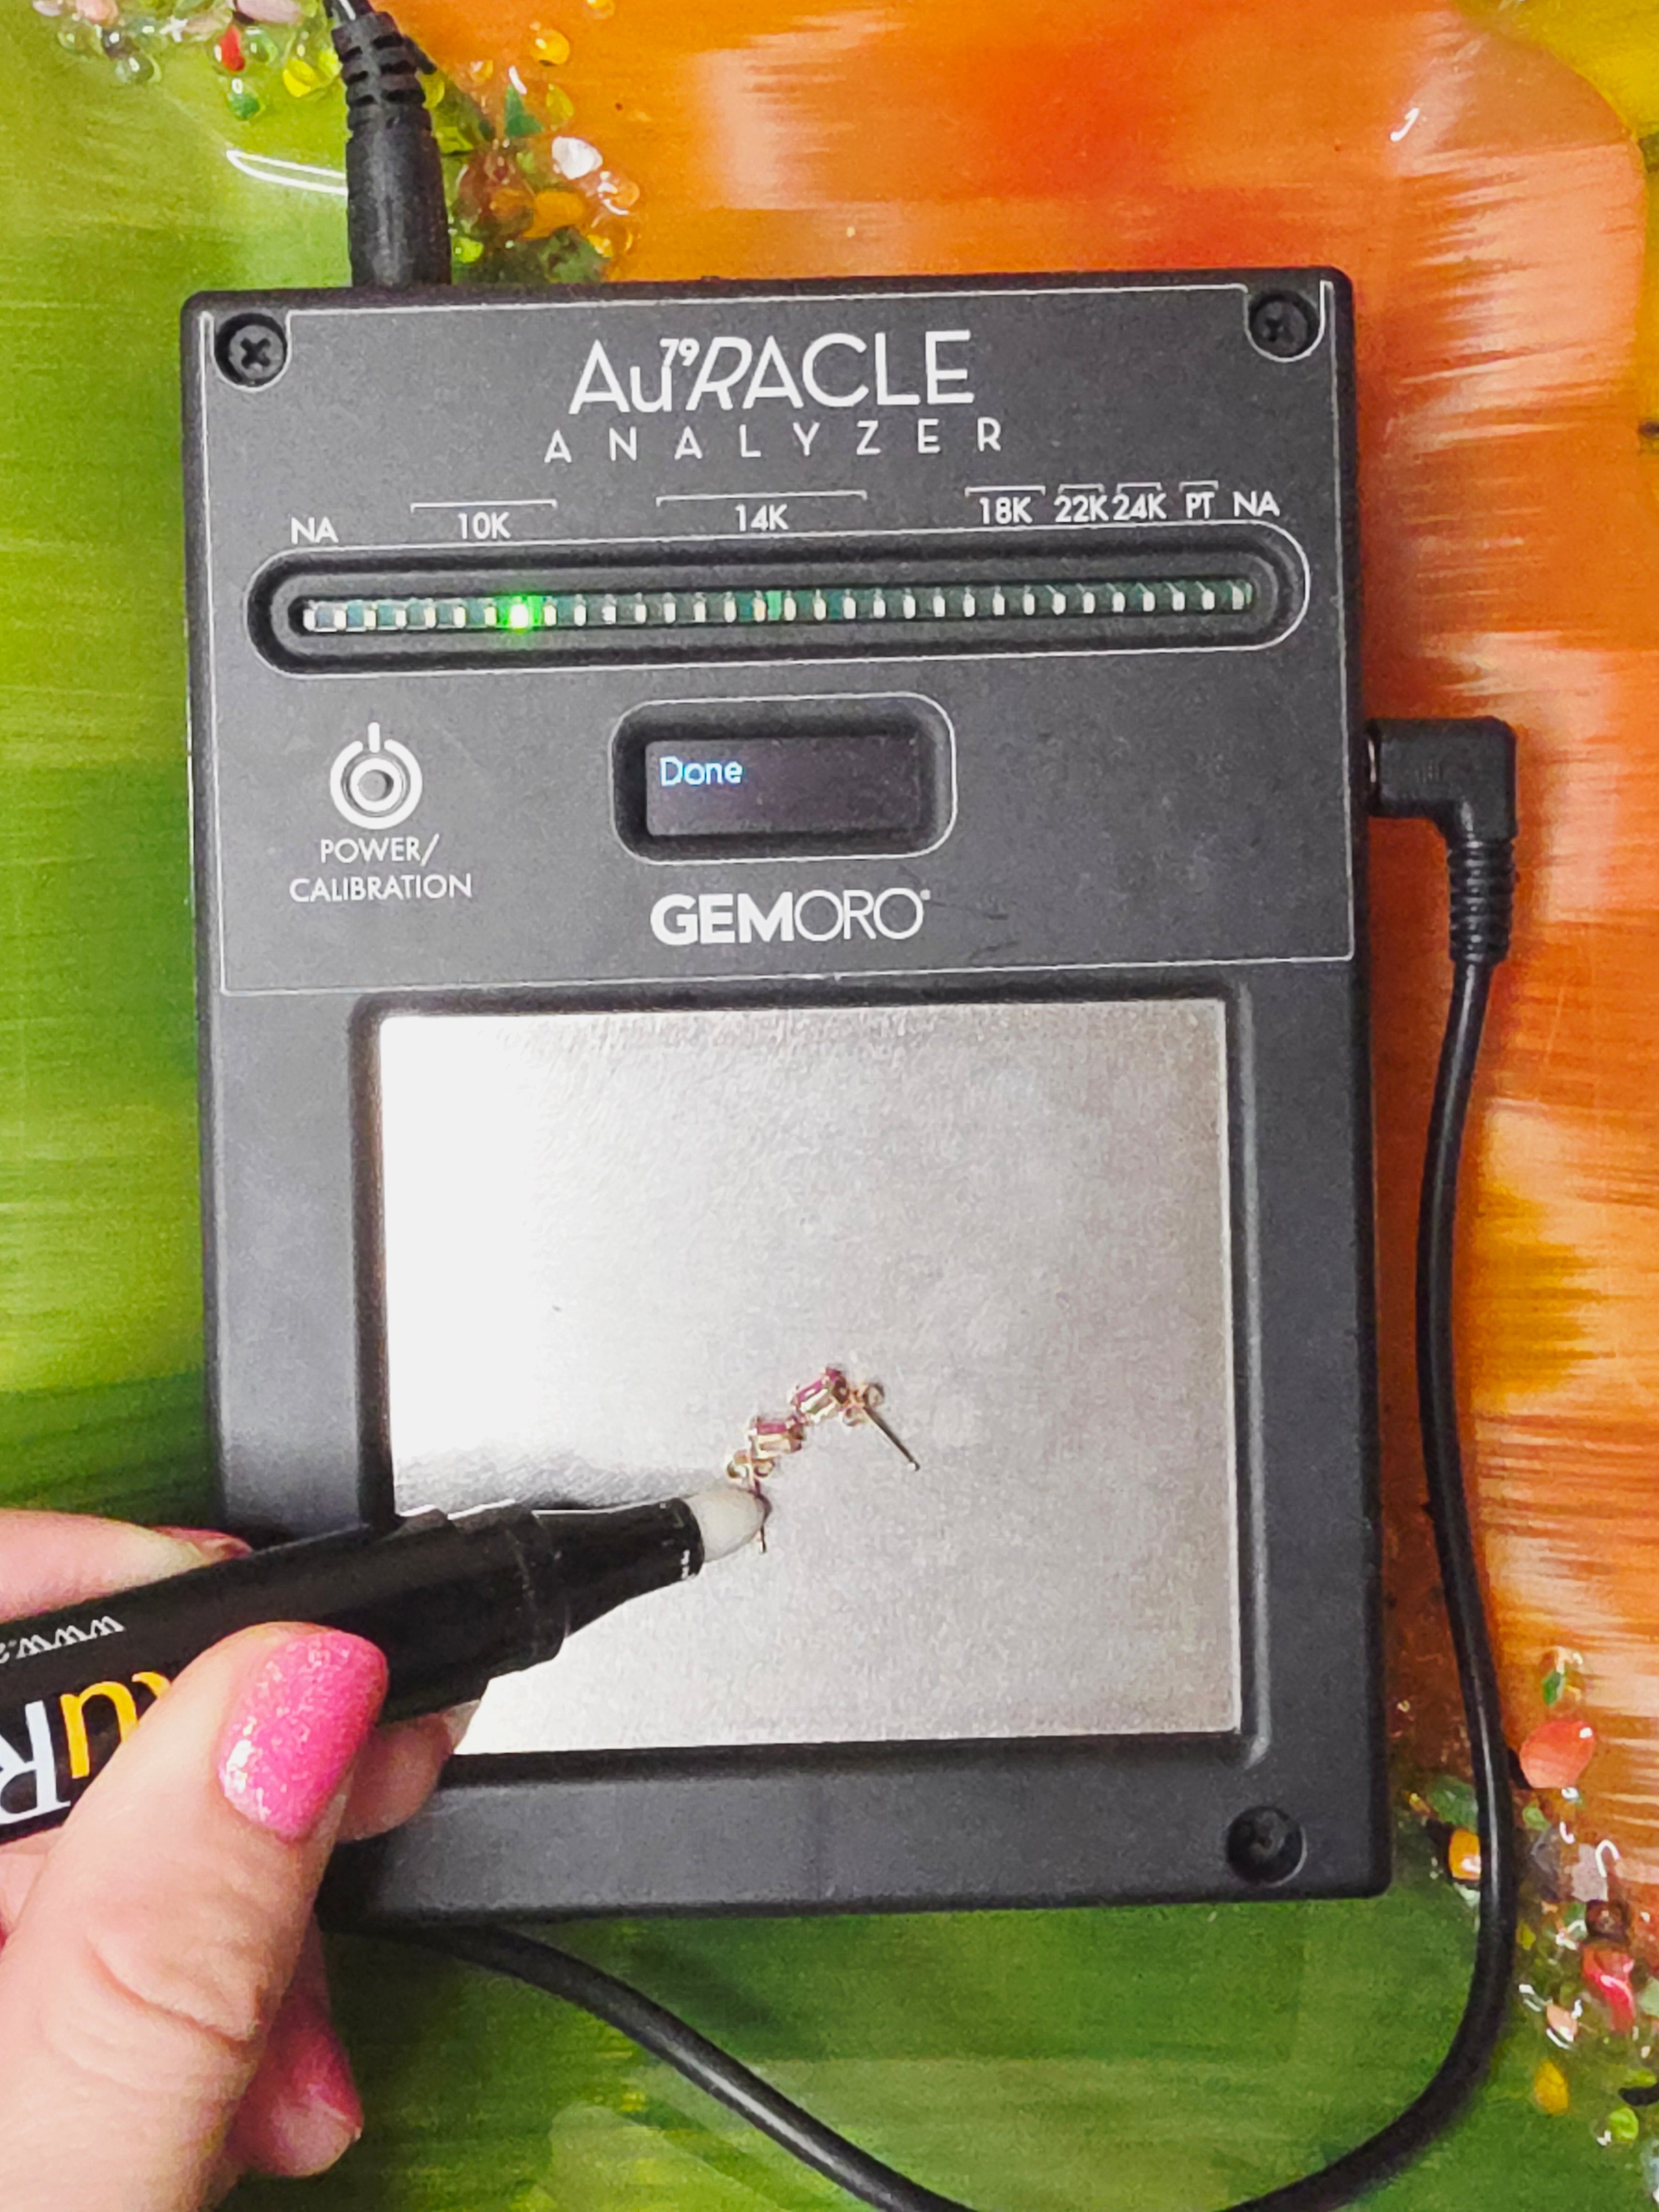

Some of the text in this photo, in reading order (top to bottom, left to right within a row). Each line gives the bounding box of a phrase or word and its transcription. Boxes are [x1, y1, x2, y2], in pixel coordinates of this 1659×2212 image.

[544, 418, 1001, 463] ANALYZER
[290, 490, 1280, 544] NA 10K 14K 18K 22K 24K PT NA
[659, 756, 744, 787] Done
[321, 833, 440, 867] POWER/
[289, 873, 473, 902] CALIBRATION
[650, 887, 924, 946] GEMORO
[0, 1672, 171, 1825] uR
